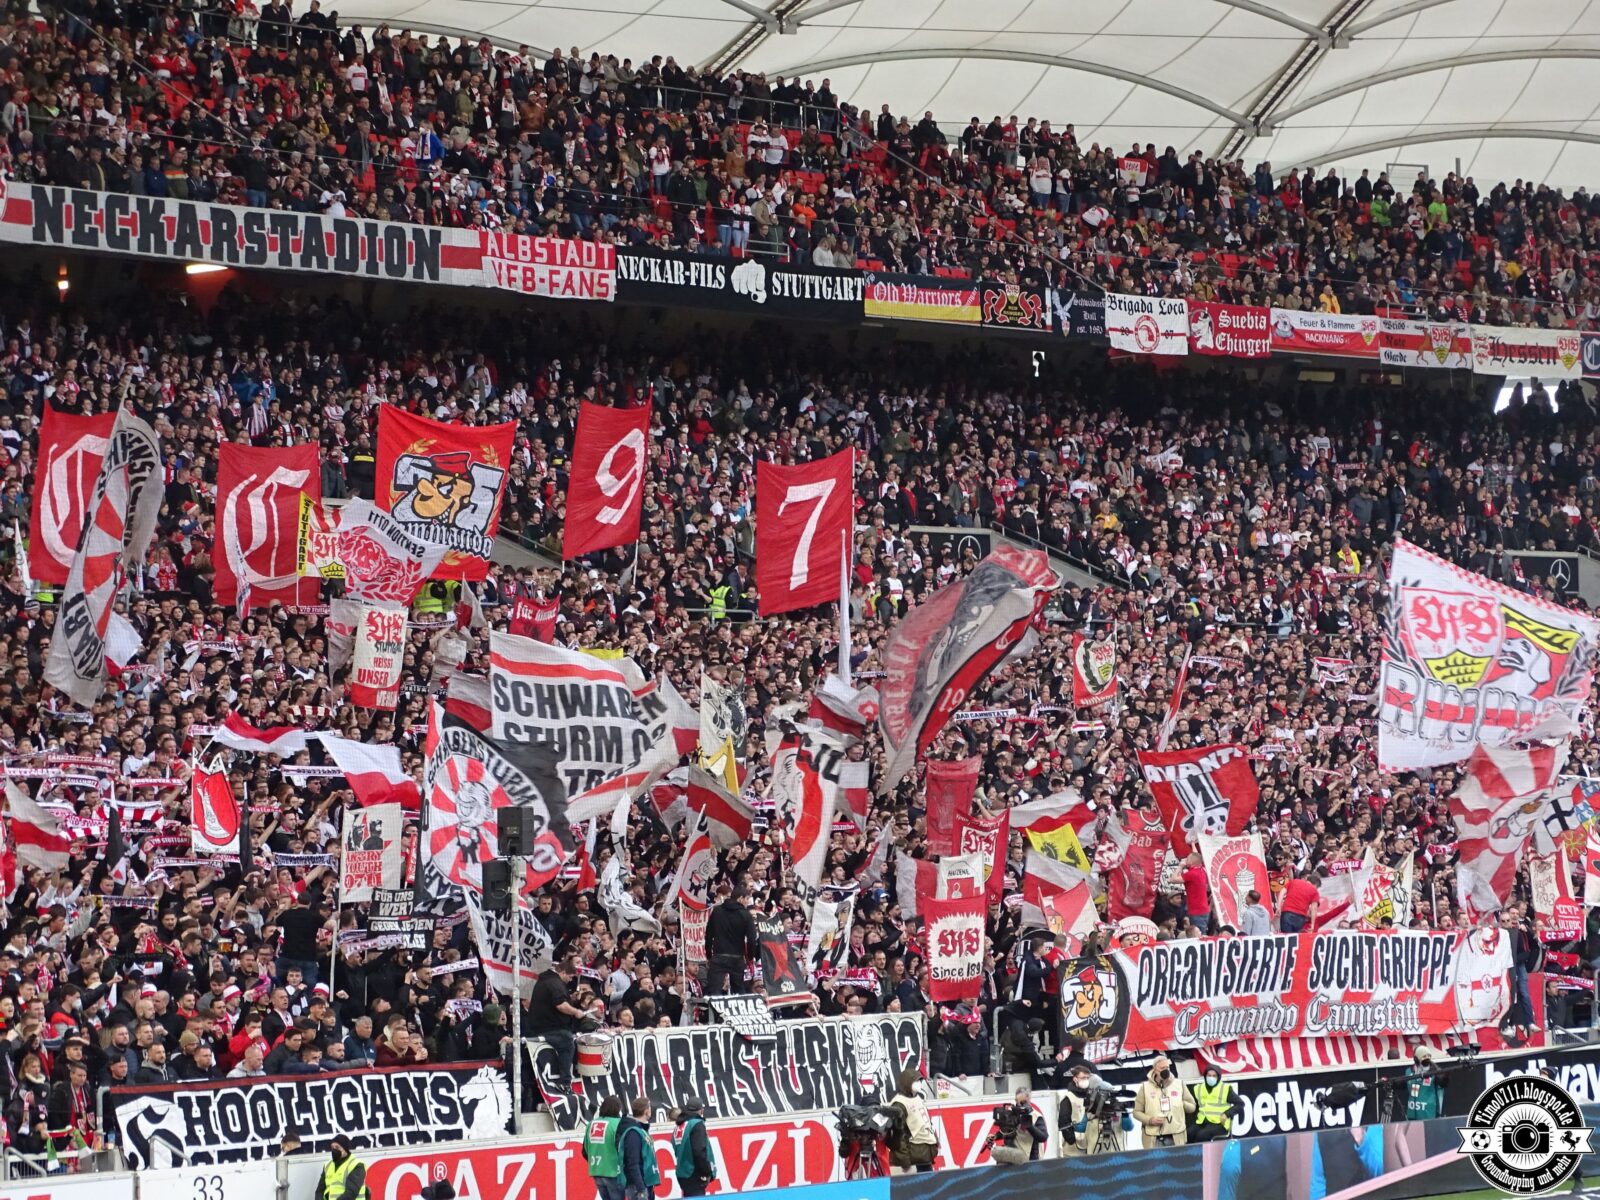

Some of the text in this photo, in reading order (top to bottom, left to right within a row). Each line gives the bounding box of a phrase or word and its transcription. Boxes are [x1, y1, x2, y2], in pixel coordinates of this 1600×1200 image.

[32, 184, 442, 282] NECKARSTADION
[486, 234, 614, 269] ALBSTADT
[616, 254, 726, 290] NECKAR-FILS
[772, 271, 866, 302] STUTTGART
[873, 280, 899, 303] Old
[901, 282, 962, 307] Warriors
[1107, 292, 1185, 316] Brigada Loca
[1218, 310, 1267, 330] Suebia
[1300, 318, 1356, 330] Feuer & Flamme
[1305, 333, 1344, 344] BACKNANG
[1487, 335, 1558, 367] Hessen
[594, 427, 646, 526] 9
[777, 477, 837, 592] 7
[1410, 595, 1499, 644] VfB
[357, 668, 389, 687] UNSER
[345, 862, 383, 873] YOUTH
[938, 928, 981, 958] VfB
[932, 962, 981, 979] Since 189
[1137, 935, 1299, 1009] ORGANISIERTE
[711, 999, 768, 1016] ULTRAS
[1174, 995, 1420, 1045] Commando Cannstatt
[174, 1071, 463, 1148] HOOLIGANS
[193, 1175, 224, 1200] 33
